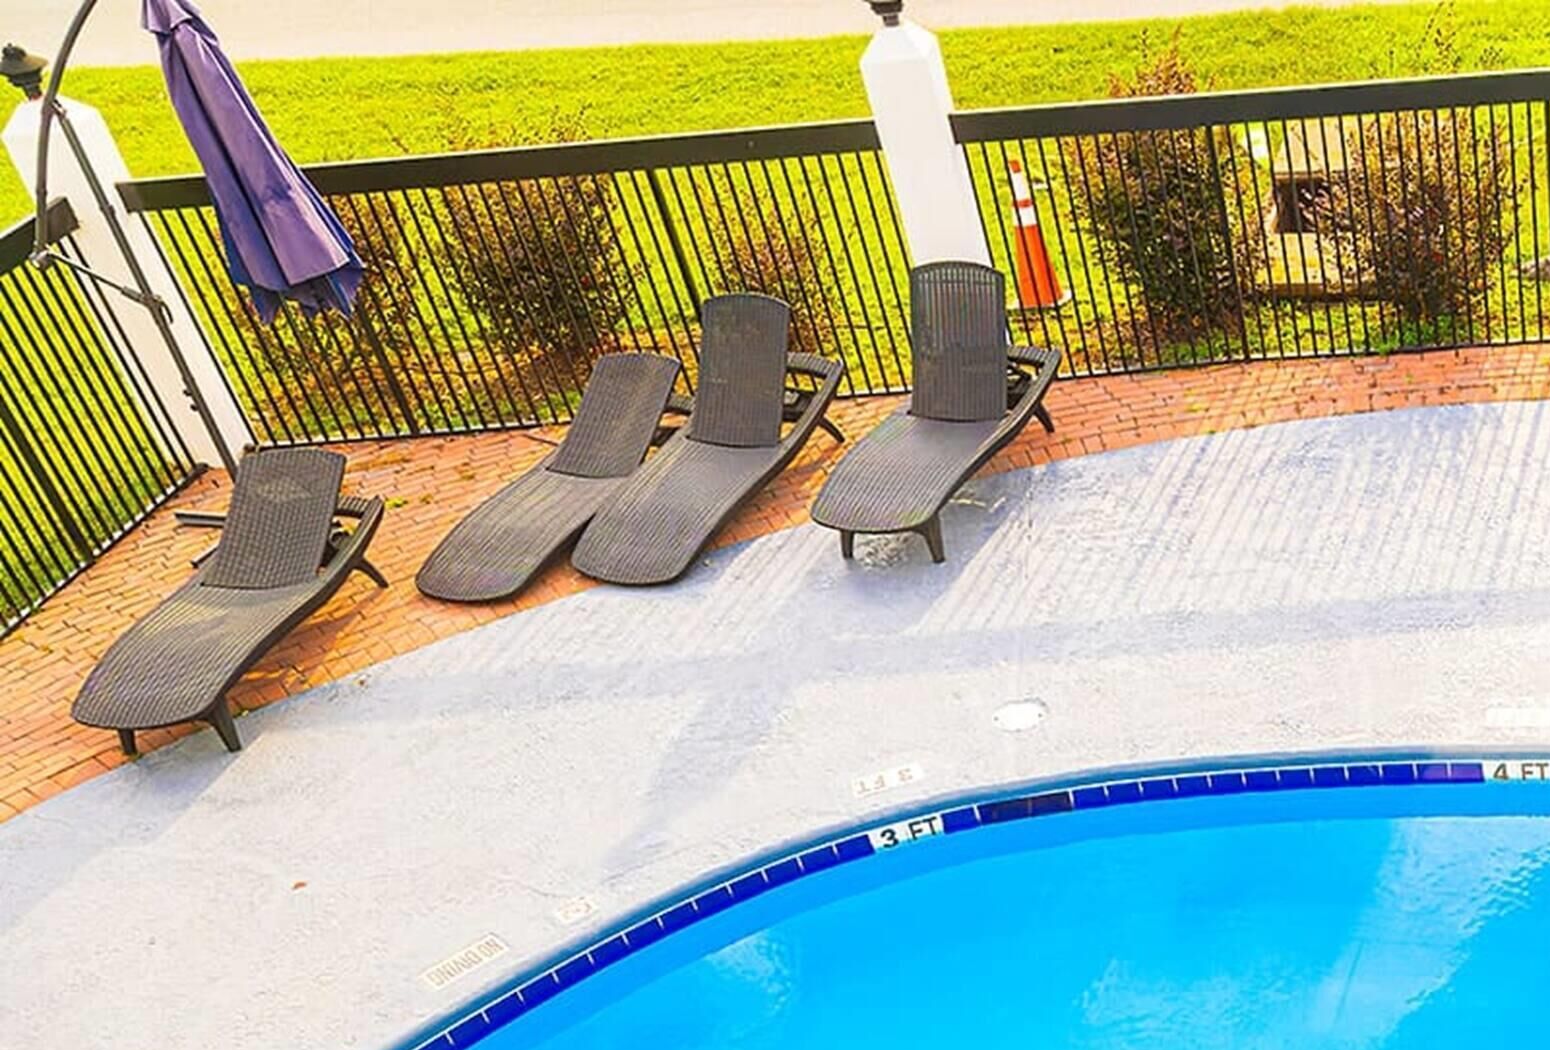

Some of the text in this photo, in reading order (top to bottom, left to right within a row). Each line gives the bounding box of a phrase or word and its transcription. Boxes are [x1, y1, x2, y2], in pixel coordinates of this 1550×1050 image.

[1493, 763, 1549, 781] 4 FT
[880, 816, 938, 848] 3 FT
